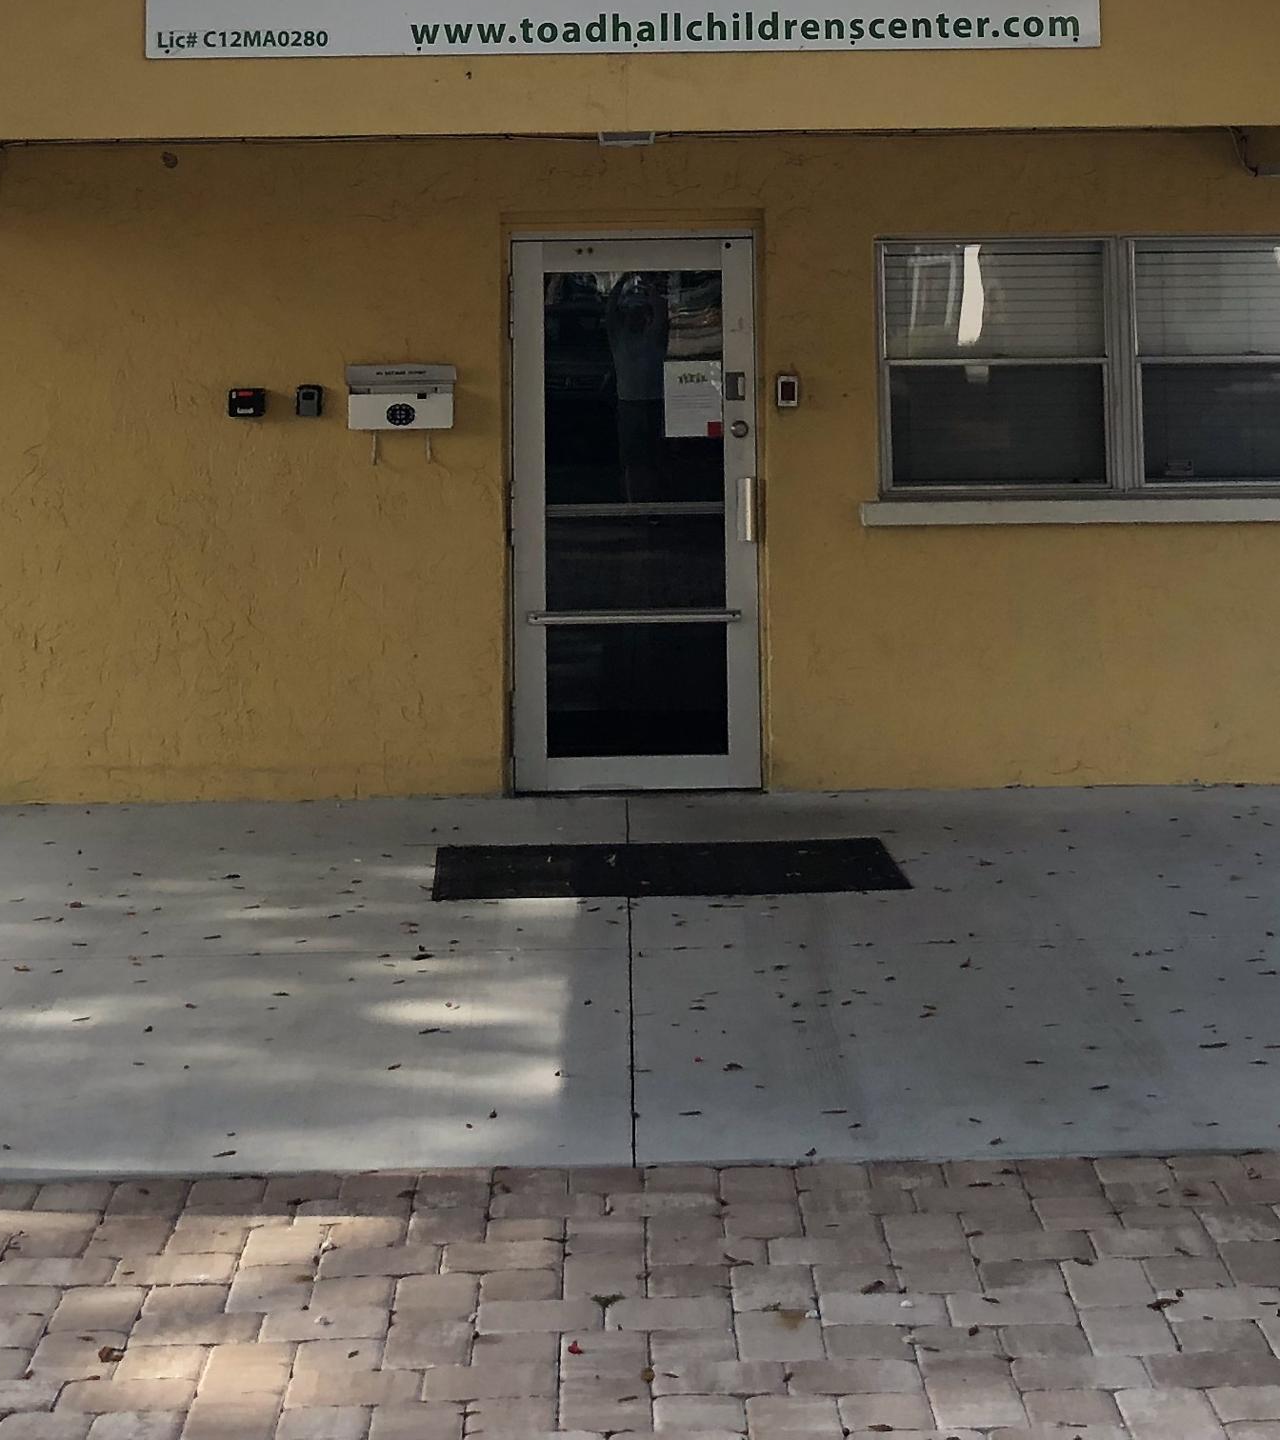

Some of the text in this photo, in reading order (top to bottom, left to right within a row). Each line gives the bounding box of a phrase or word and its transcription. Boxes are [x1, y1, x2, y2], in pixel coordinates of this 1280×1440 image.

[158, 30, 329, 49] Lic# C12MA0280
[411, 12, 1079, 45] www.toadhallchildrenscenter.com
